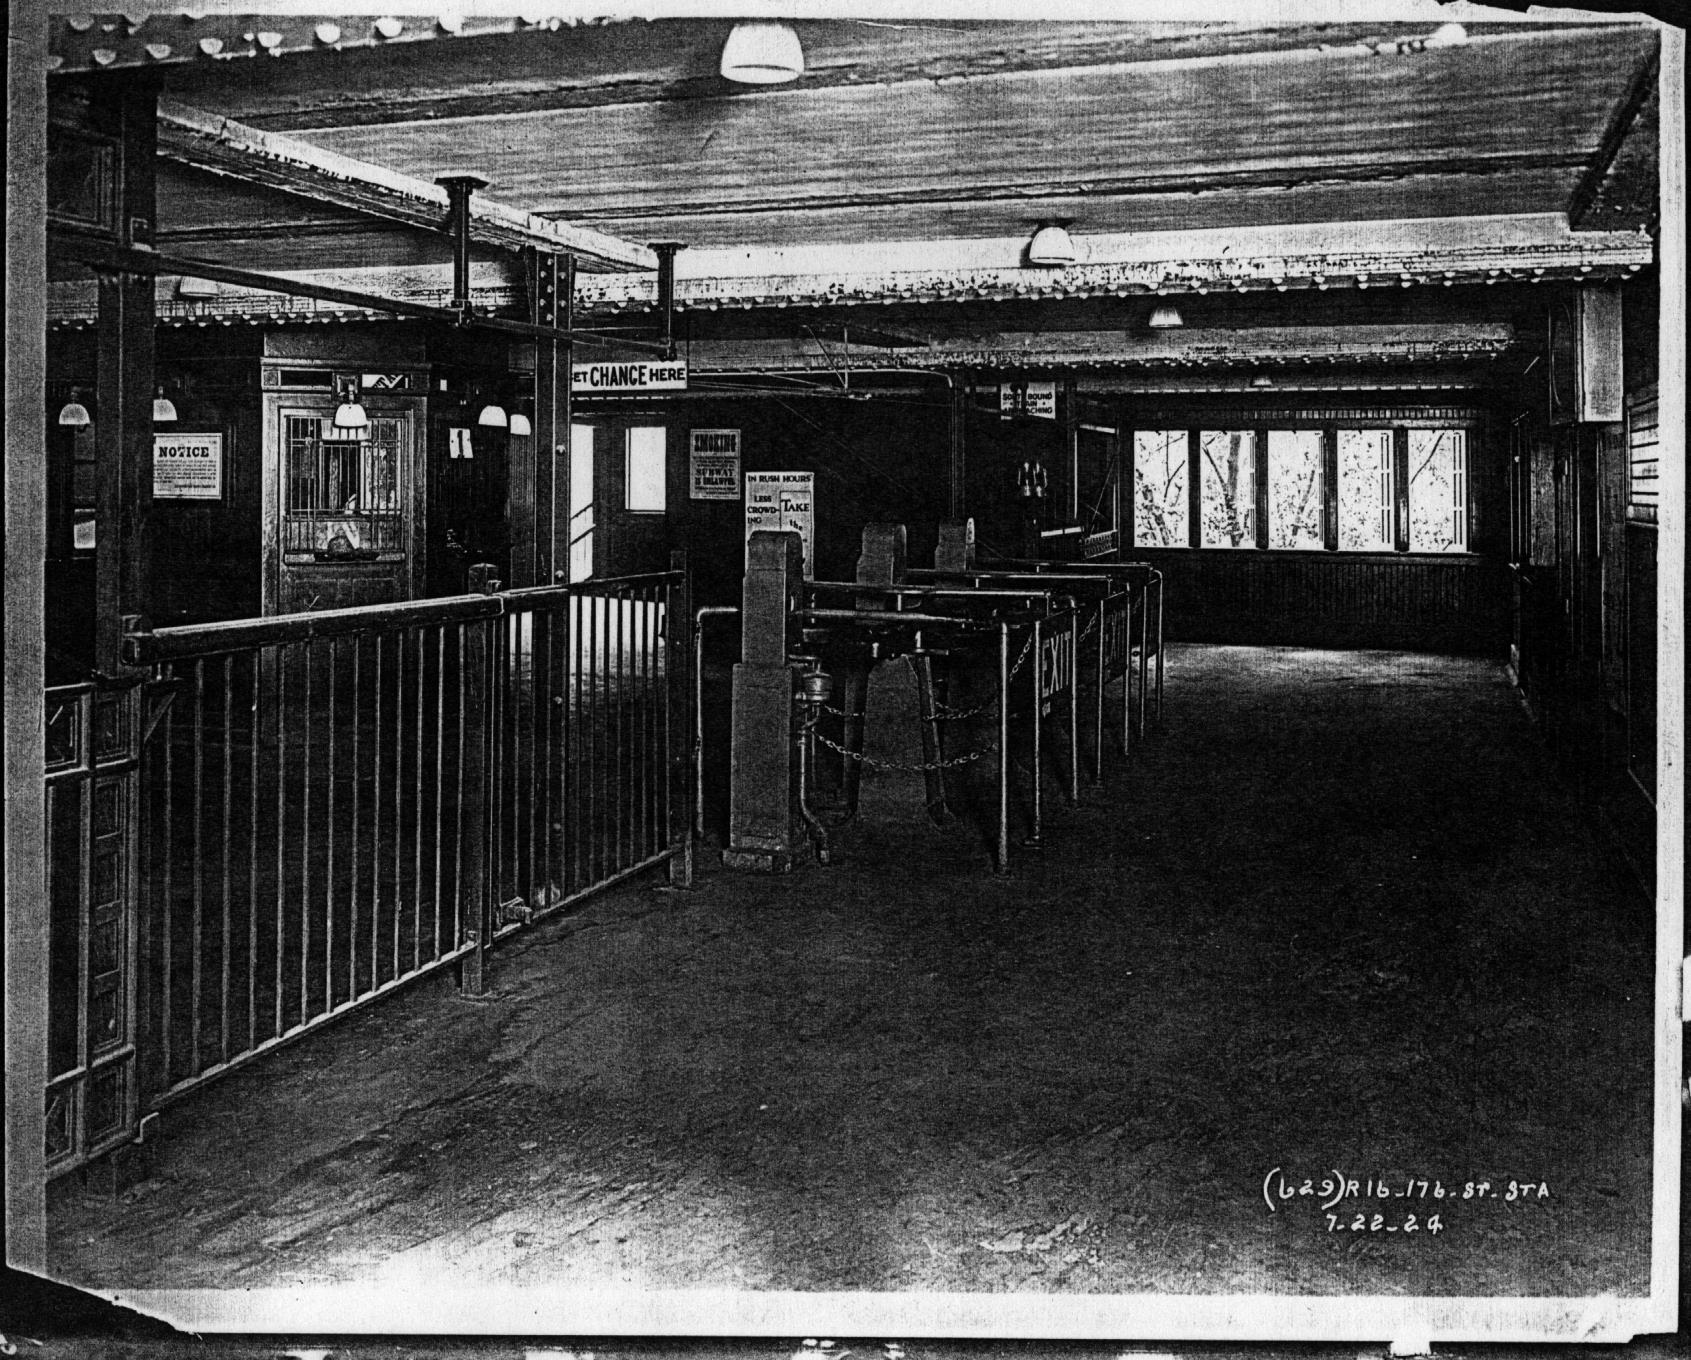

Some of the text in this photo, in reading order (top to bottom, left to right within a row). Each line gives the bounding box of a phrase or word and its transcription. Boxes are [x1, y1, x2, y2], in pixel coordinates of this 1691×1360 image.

[571, 365, 686, 387] ET CHANGE HERE
[1028, 392, 1053, 400] BOUND
[694, 434, 736, 453] SMOKING
[158, 446, 210, 458] NOTICE
[747, 474, 812, 483] IN RUSH HOURS
[754, 495, 772, 503] LESS
[1042, 631, 1072, 698] EXIT
